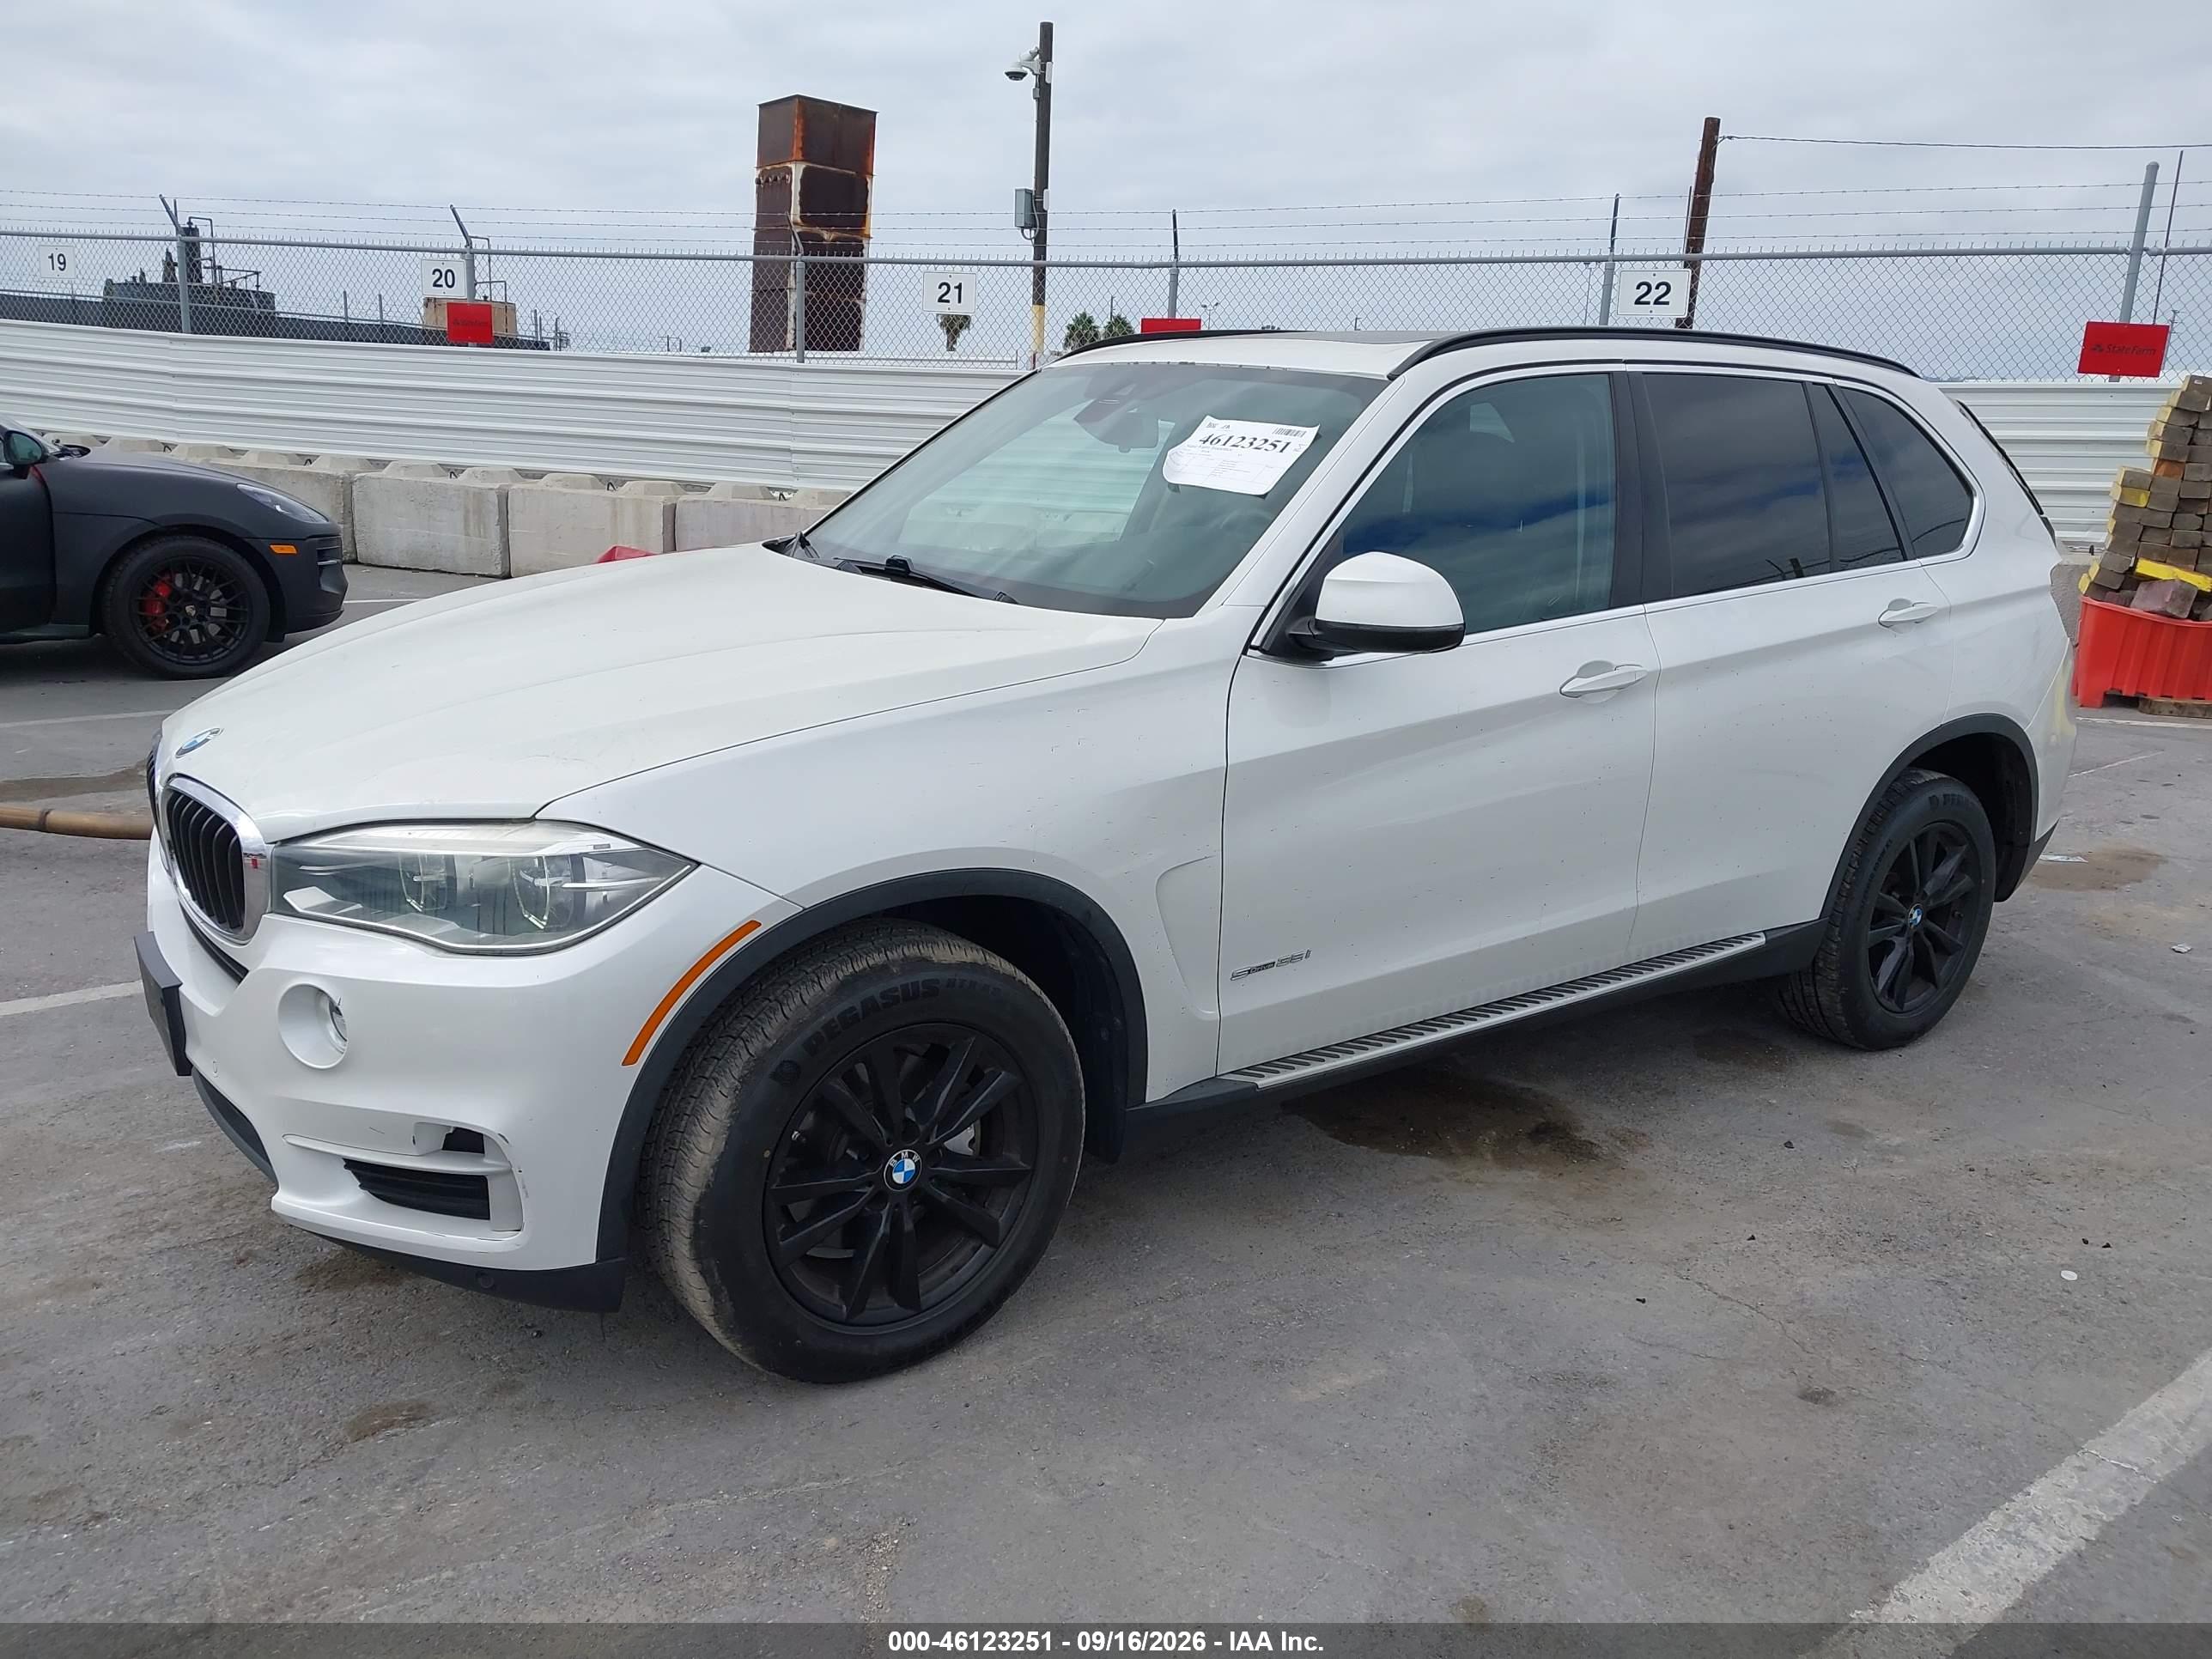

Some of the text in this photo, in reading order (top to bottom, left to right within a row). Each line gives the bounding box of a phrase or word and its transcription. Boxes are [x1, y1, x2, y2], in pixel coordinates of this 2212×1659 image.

[47, 252, 67, 271] 19
[431, 268, 456, 289] 20
[937, 282, 963, 304] 21
[1633, 281, 1672, 306] 22
[1199, 433, 1291, 453] 46123251
[802, 977, 941, 1057] PEGASUS
